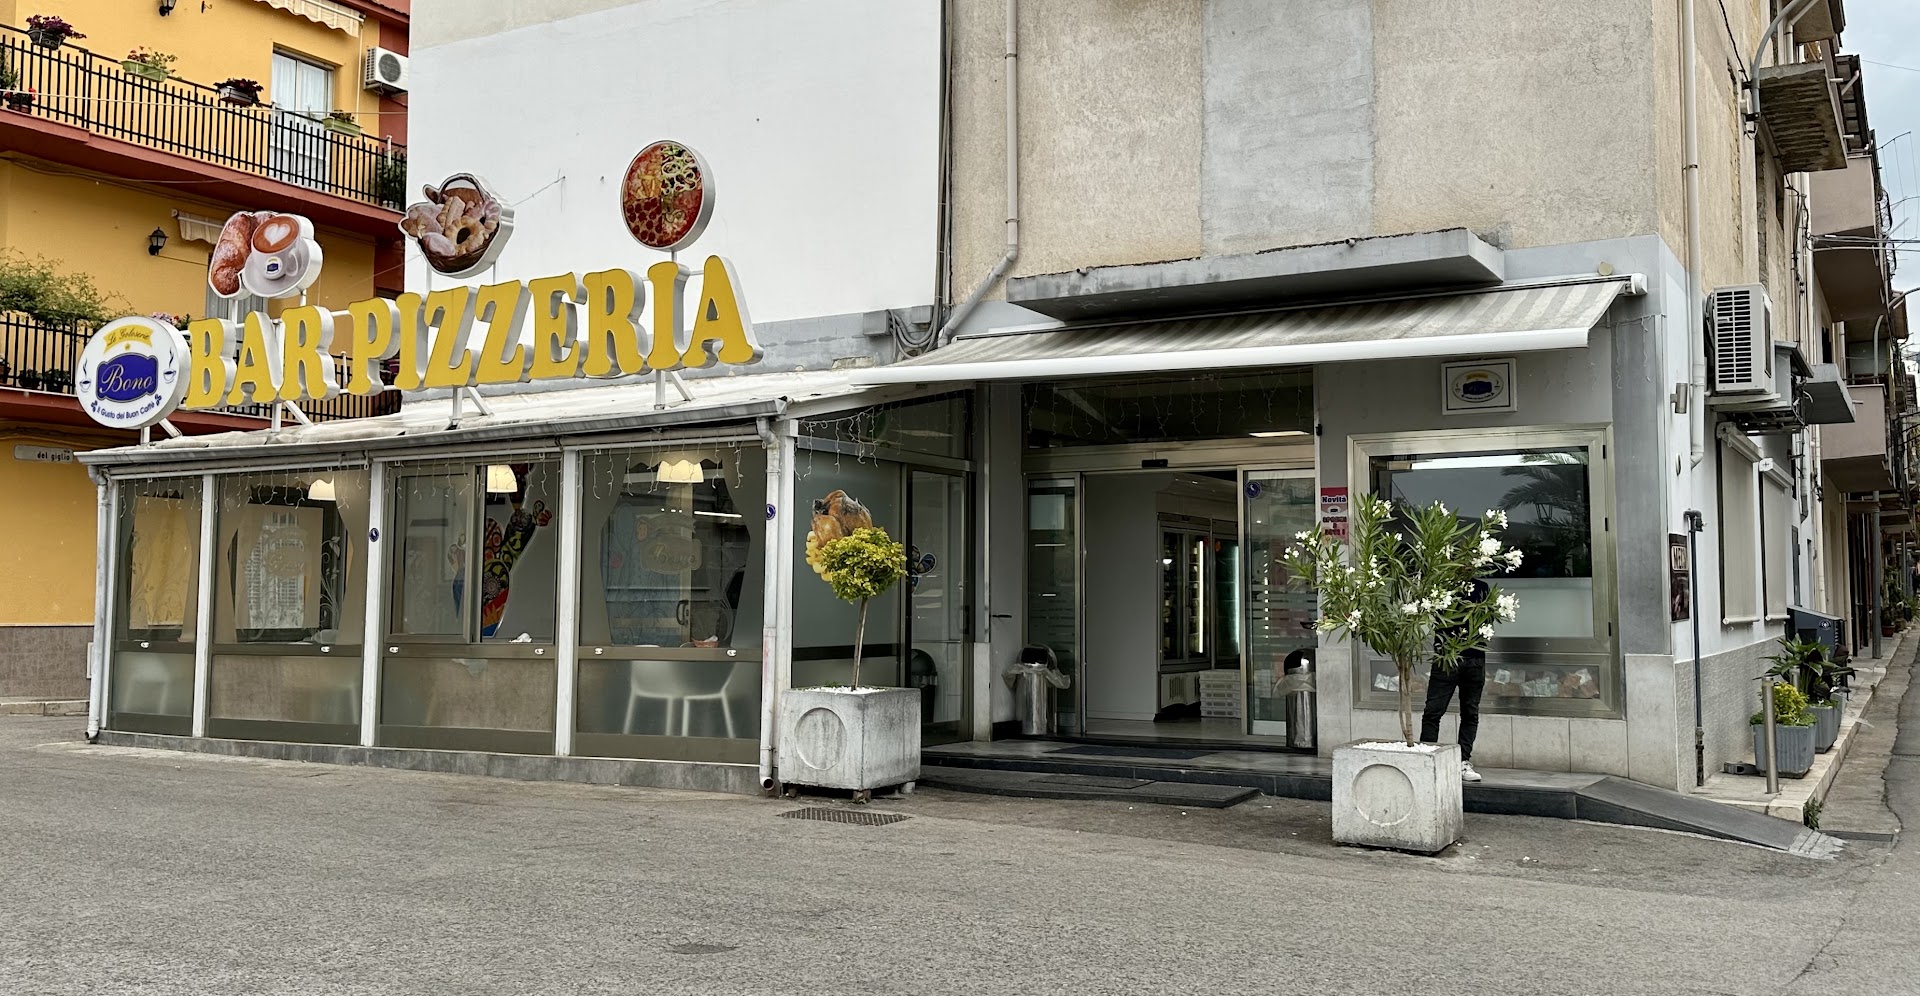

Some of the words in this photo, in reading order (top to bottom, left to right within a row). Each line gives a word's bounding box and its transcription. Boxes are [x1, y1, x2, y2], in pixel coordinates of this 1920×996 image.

[186, 305, 331, 409] BAR
[347, 254, 757, 397] PIZZERIA
[99, 363, 153, 393] Bono
[101, 408, 115, 419] Gusto
[116, 411, 125, 419] del
[126, 410, 139, 419] Buon
[37, 451, 48, 459] del
